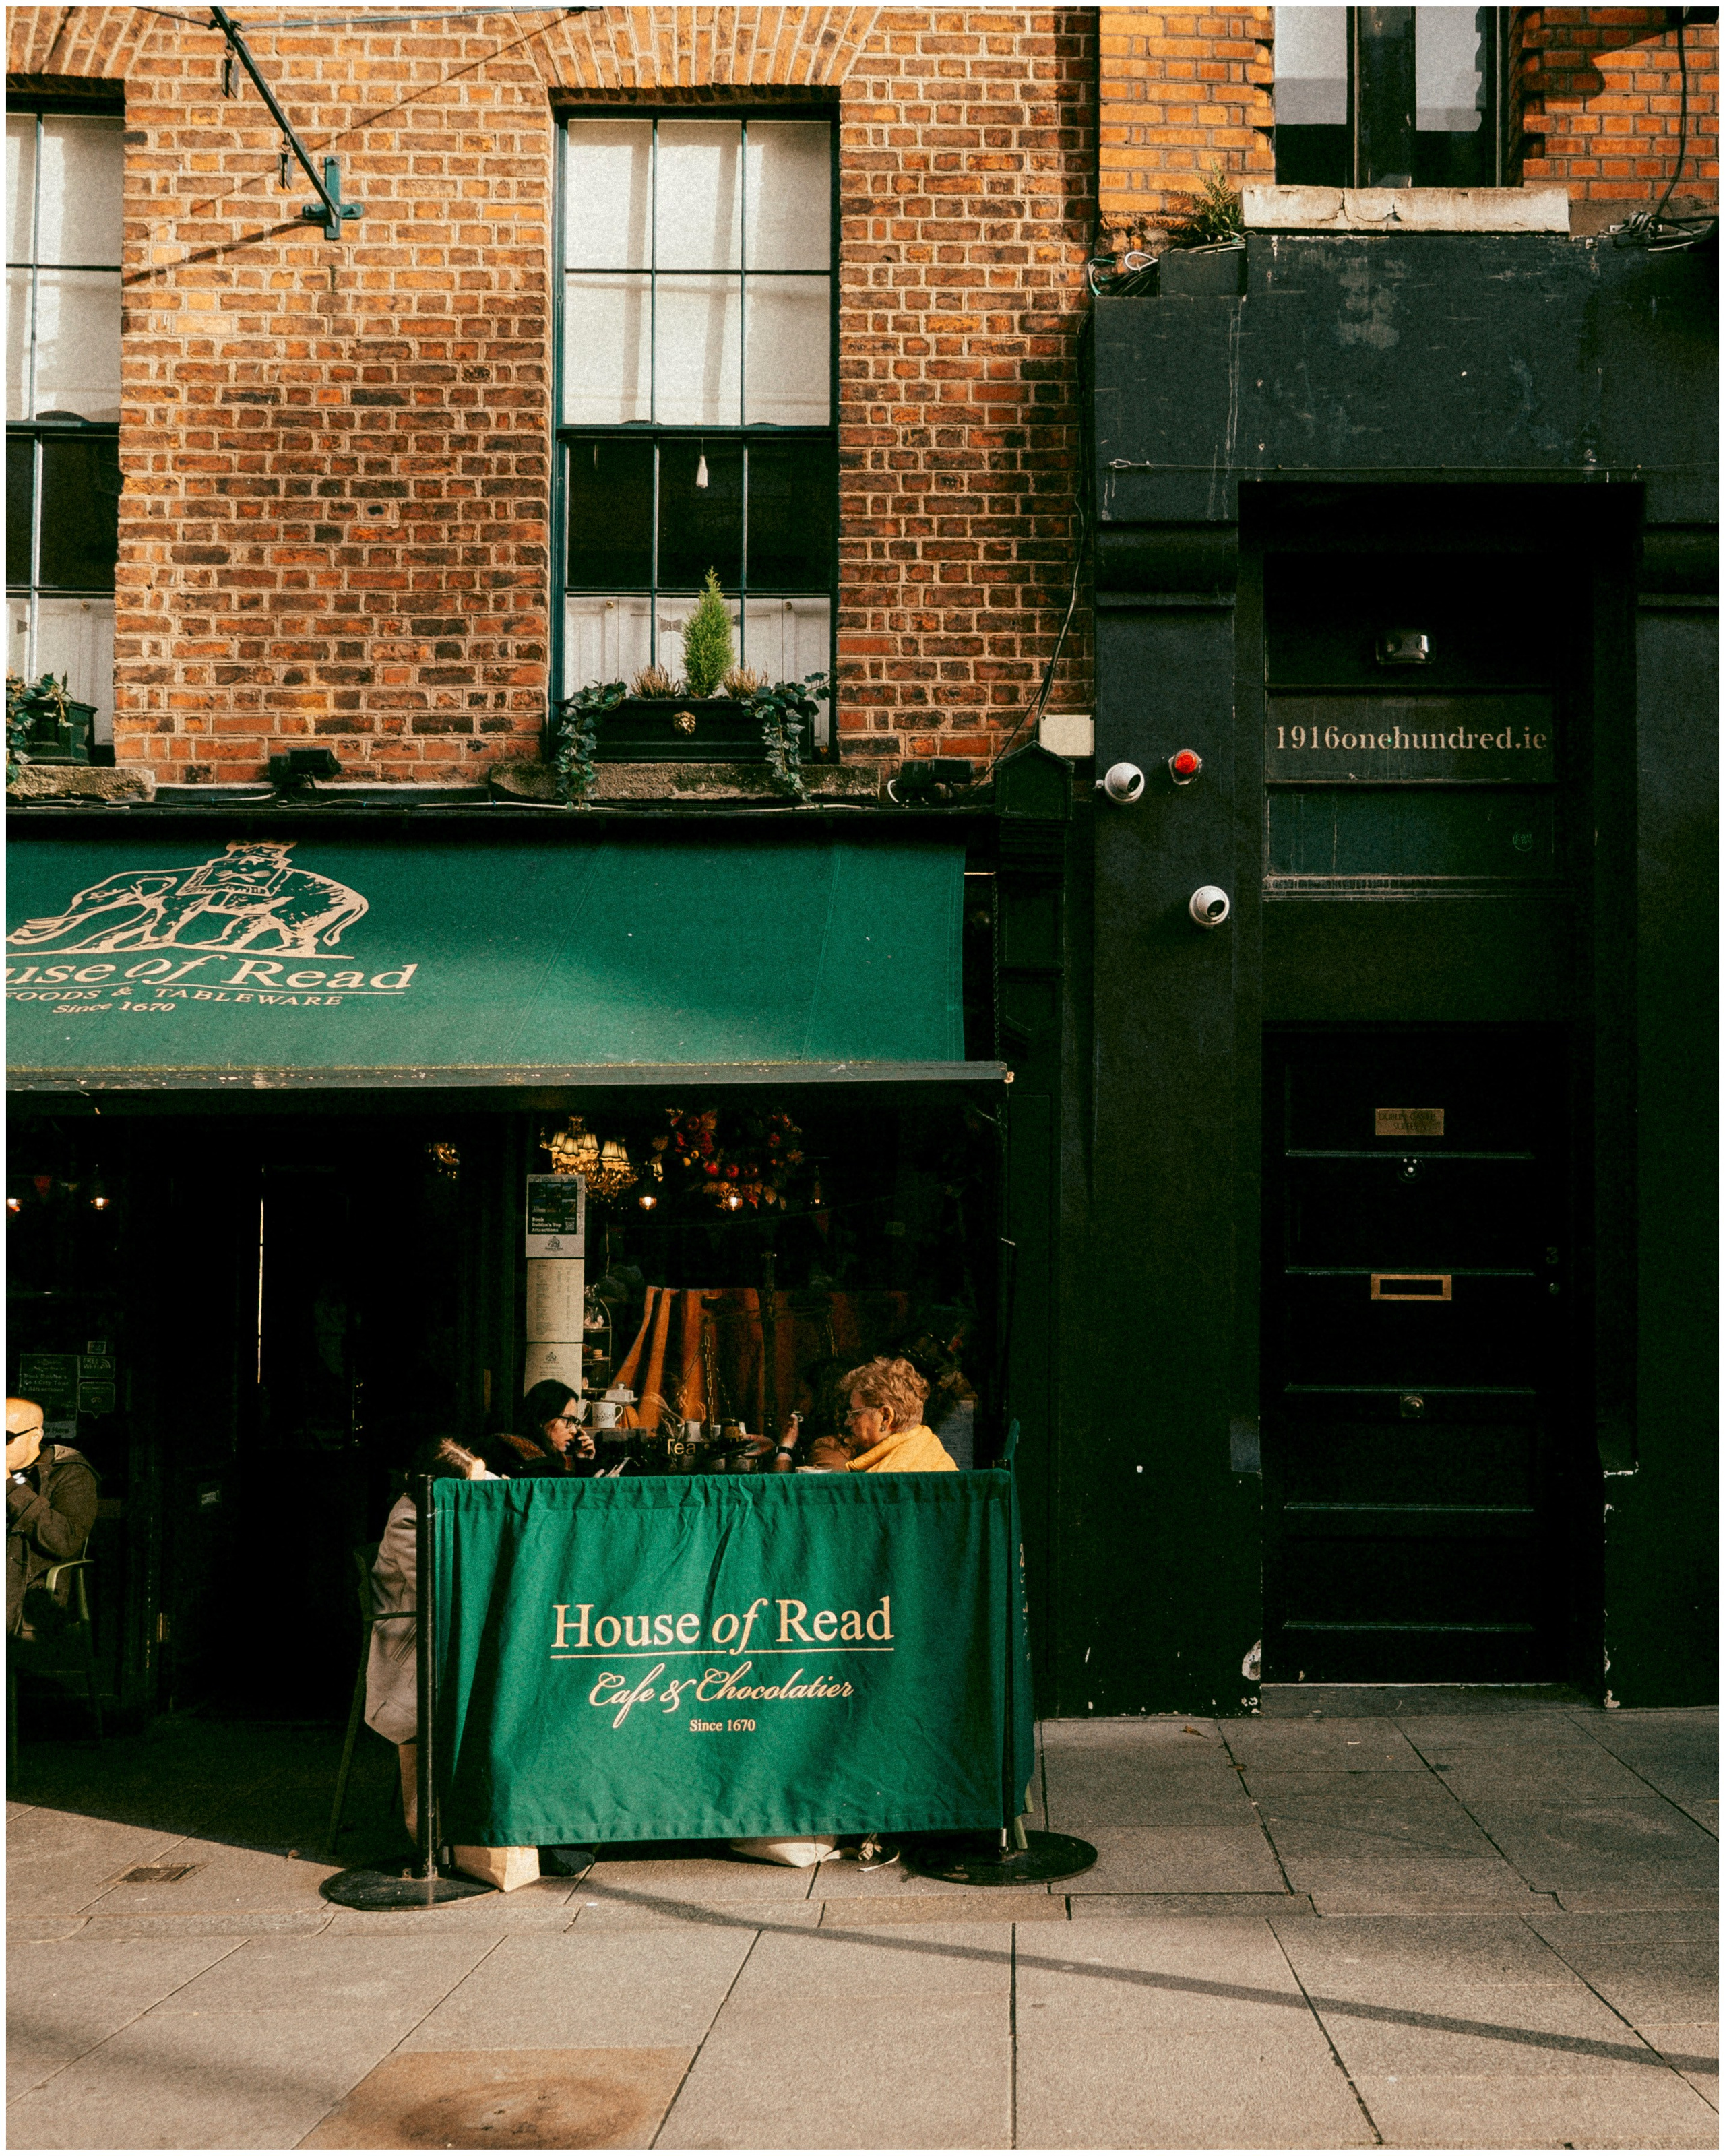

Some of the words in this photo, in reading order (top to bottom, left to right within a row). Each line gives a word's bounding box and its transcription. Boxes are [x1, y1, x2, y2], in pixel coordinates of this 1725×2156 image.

[1276, 725, 1548, 750] 1916onehundred.ie
[124, 954, 228, 985] of
[220, 959, 418, 989] Read
[111, 986, 135, 997] &
[155, 988, 344, 1005] TABLEWARE
[52, 1002, 113, 1013] Since
[117, 1001, 176, 1012] 1670
[667, 1438, 696, 1455] Tea
[550, 1603, 700, 1648] House
[712, 1597, 769, 1655] of
[775, 1595, 895, 1643] Read
[588, 1663, 666, 1729] Cafe
[660, 1678, 697, 1713] &
[695, 1661, 854, 1703] Chocolatier
[689, 1719, 723, 1732] Since
[726, 1718, 756, 1732] 1670
